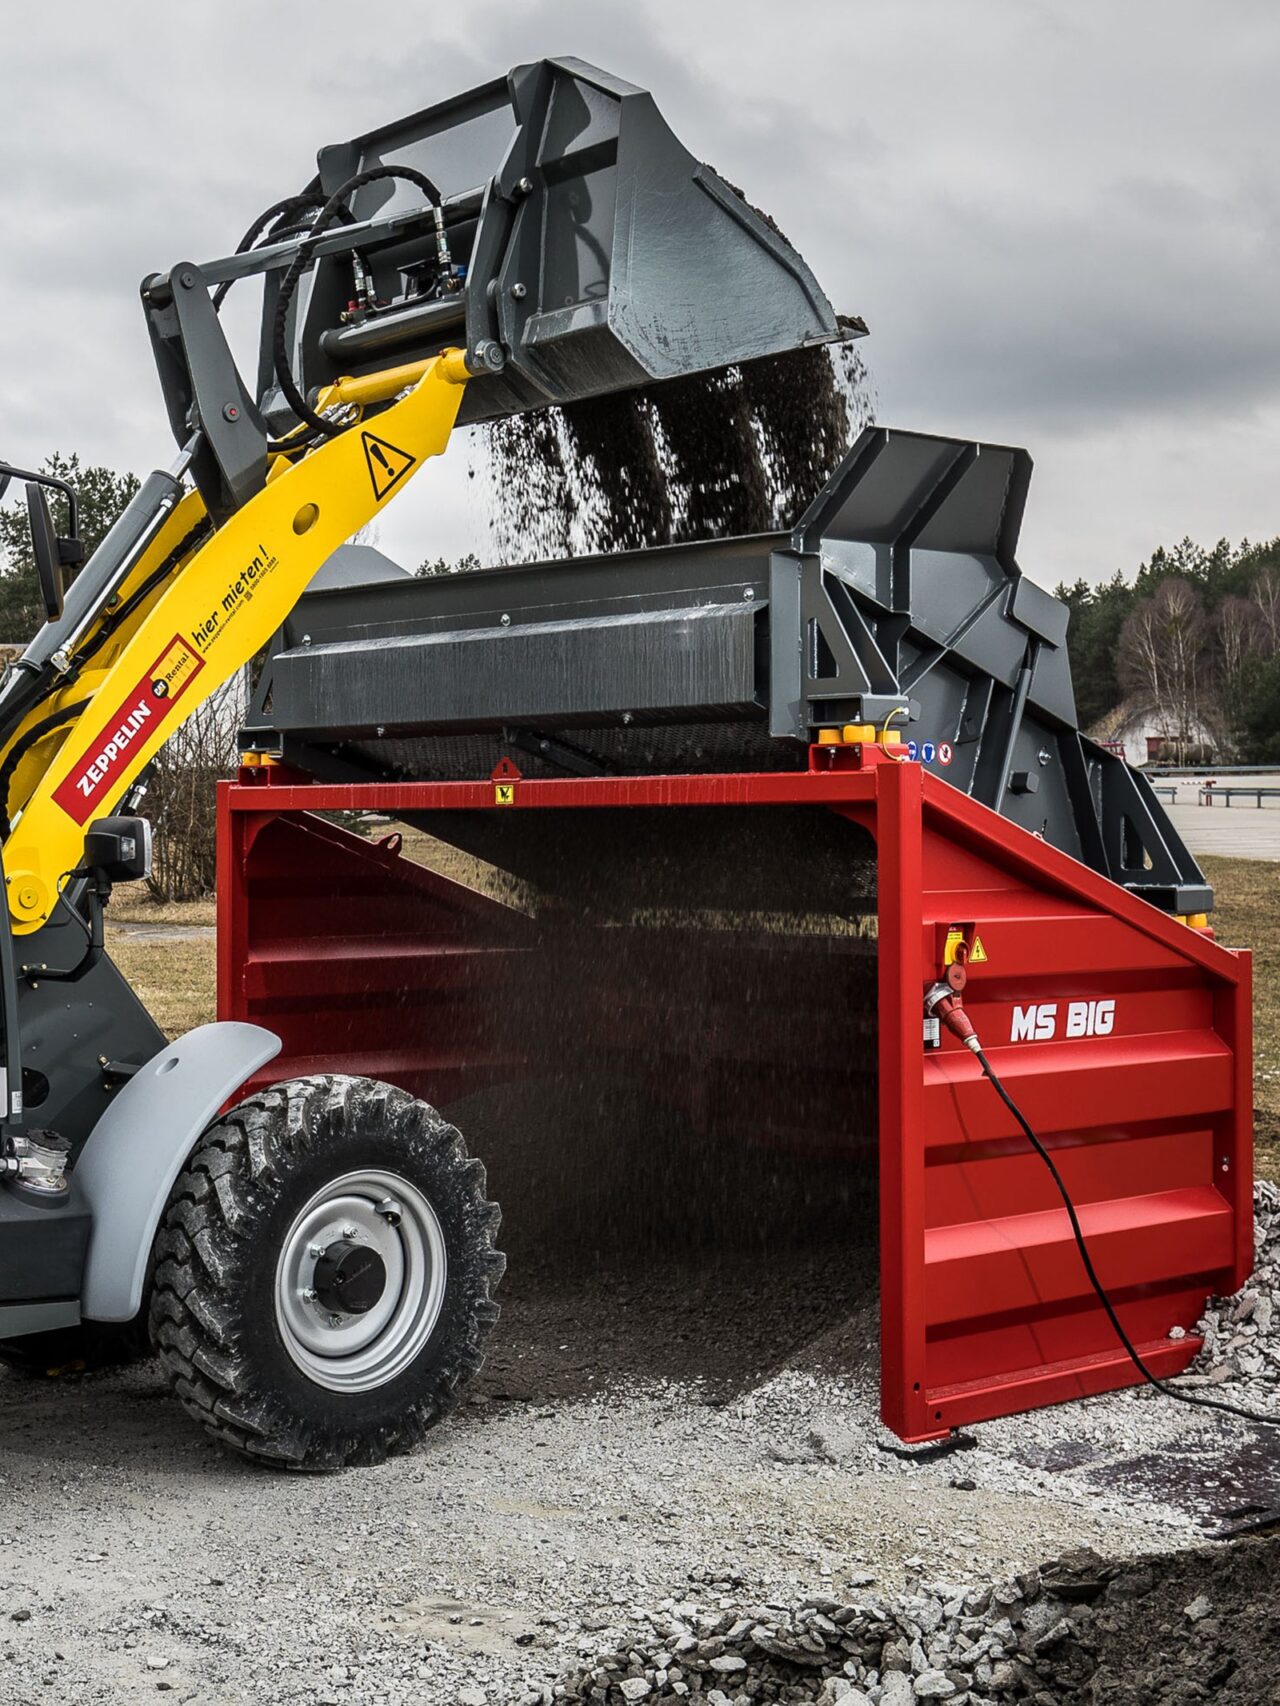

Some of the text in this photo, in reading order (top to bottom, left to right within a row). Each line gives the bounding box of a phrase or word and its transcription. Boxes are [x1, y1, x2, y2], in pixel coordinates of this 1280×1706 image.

[191, 611, 218, 647] hier
[222, 556, 263, 612] mieten
[76, 700, 152, 797] ZEPPELIN
[165, 652, 189, 682] Rental
[1010, 1000, 1116, 1042] MS BIG
